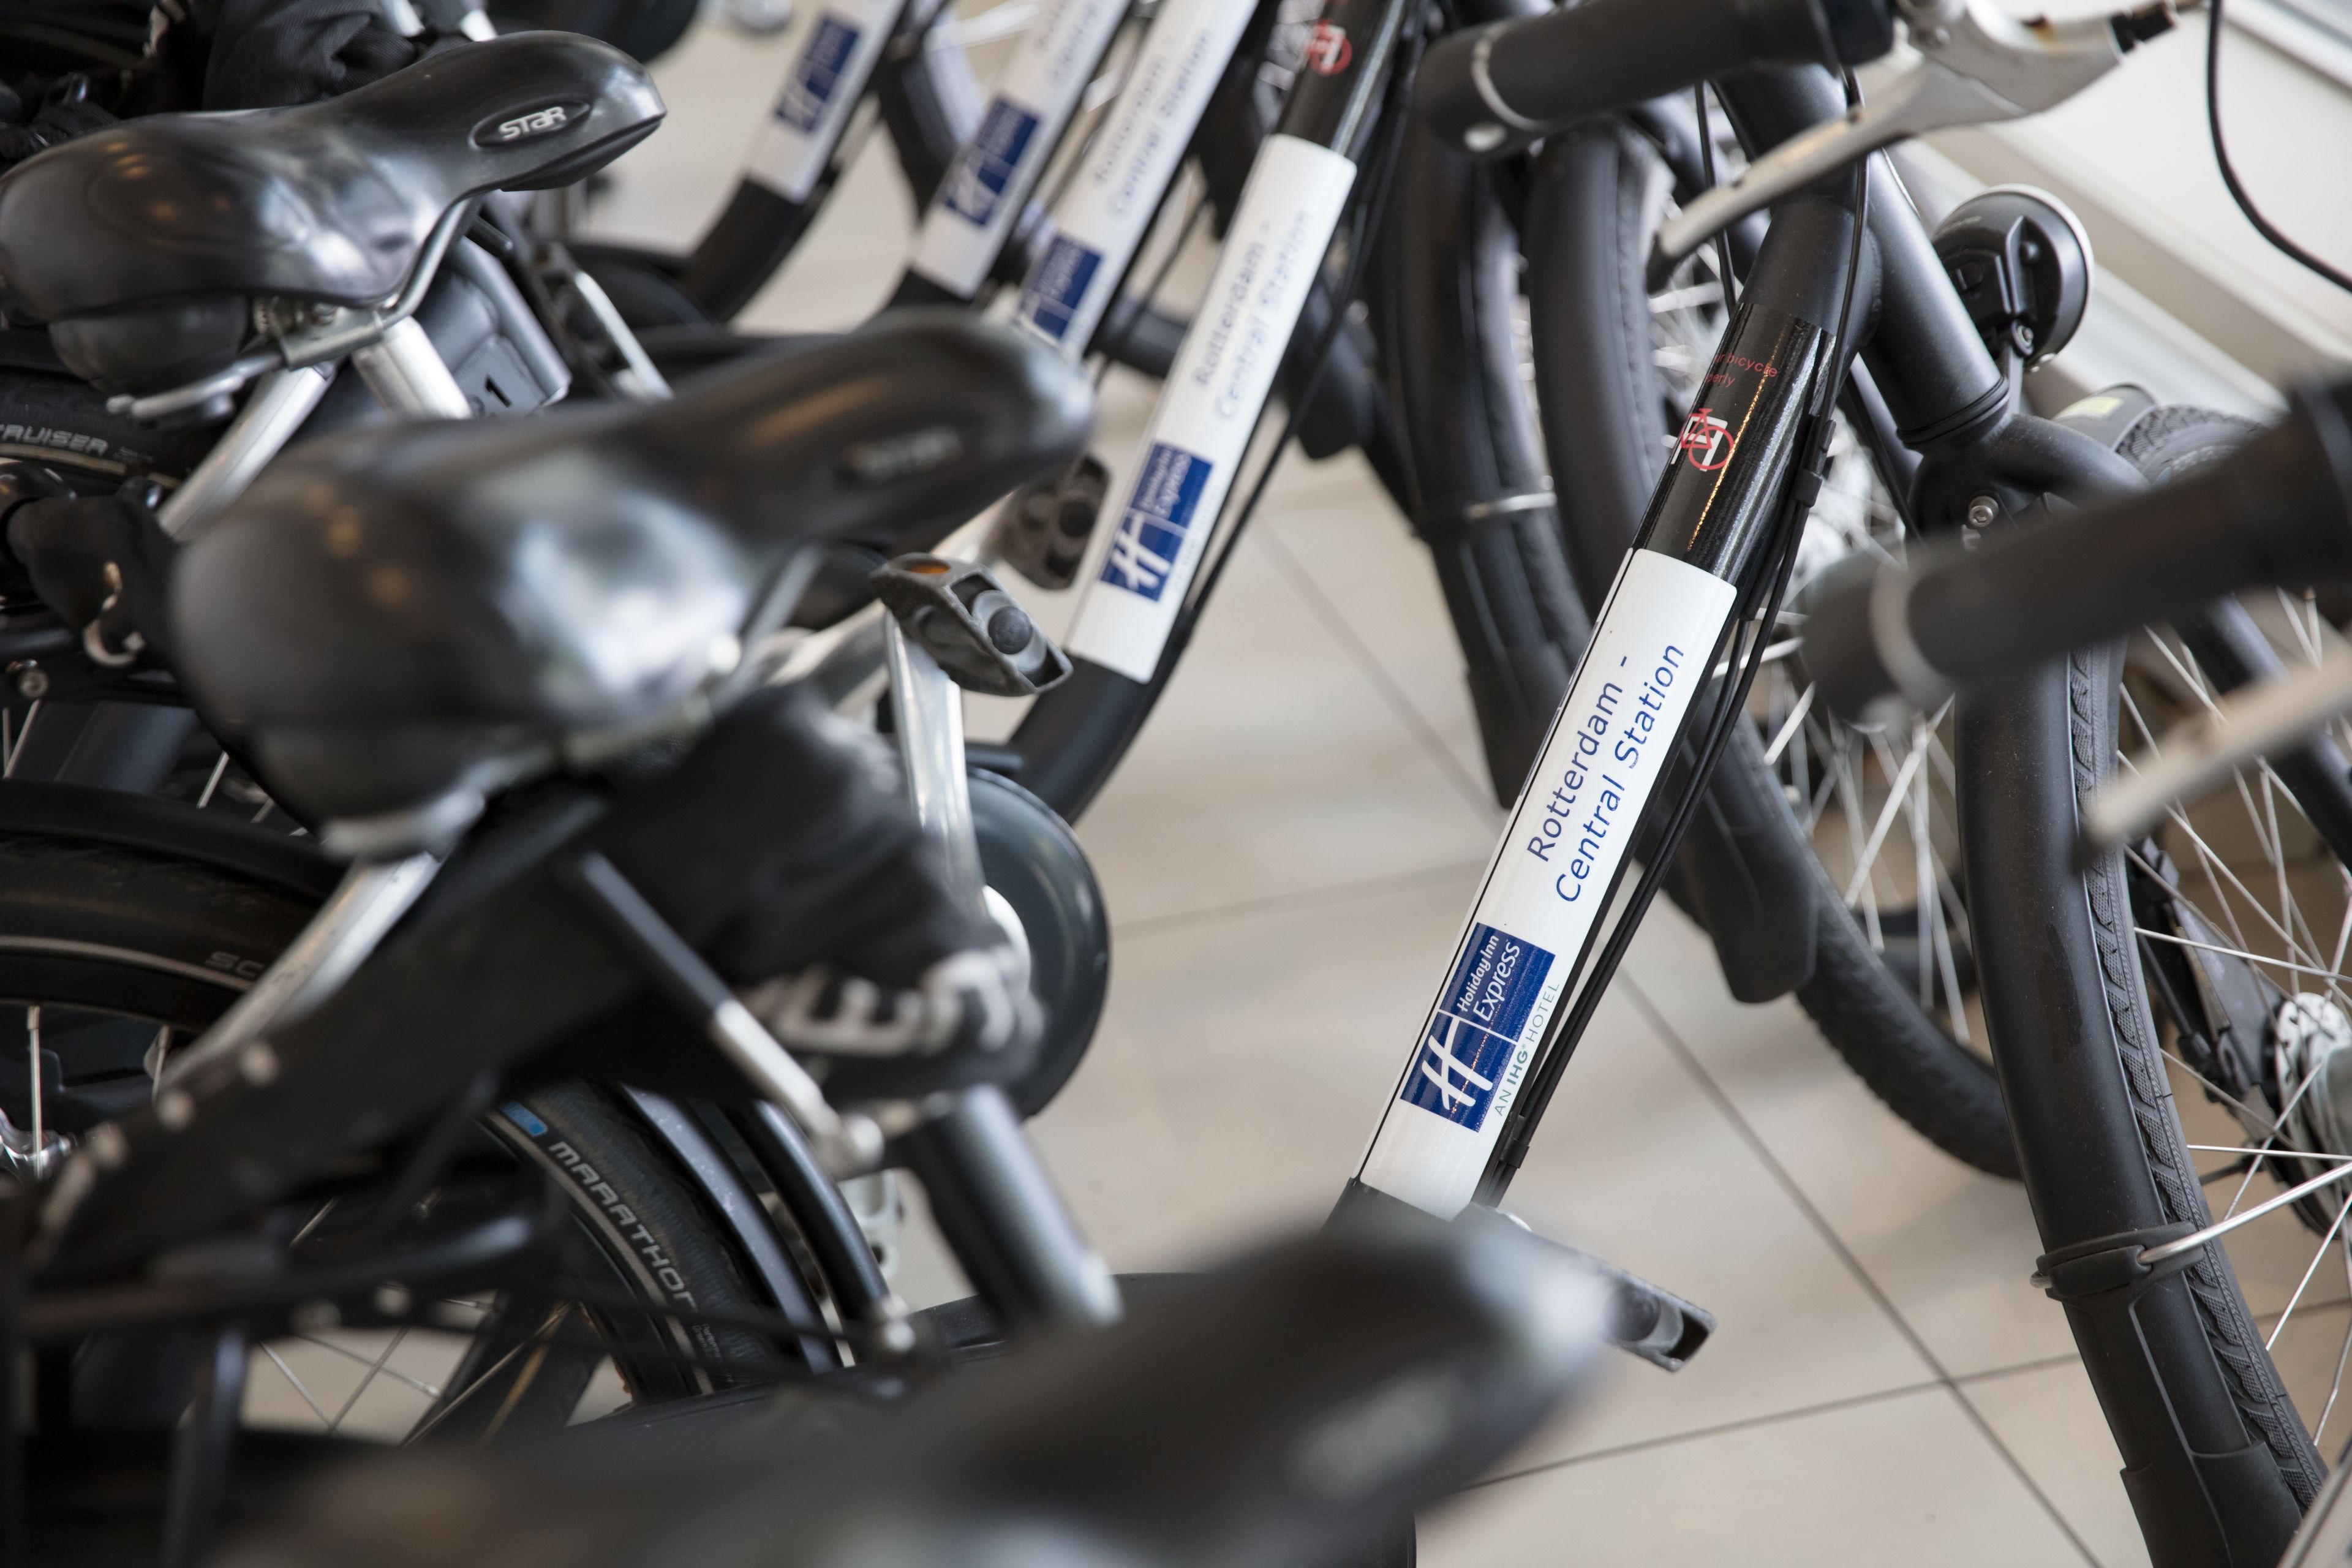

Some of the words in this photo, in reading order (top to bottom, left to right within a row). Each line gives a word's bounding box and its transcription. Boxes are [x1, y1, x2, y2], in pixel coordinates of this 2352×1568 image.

[1726, 352, 1778, 377] bicycle
[0, 424, 109, 456] RUISER
[1527, 682, 1623, 862] Rotterdam
[1556, 774, 1625, 902] Central
[1614, 645, 1684, 770] Station
[1457, 957, 1491, 1012] Holiday
[1480, 935, 1499, 959] Inn
[1472, 941, 1520, 1022] Express
[1494, 1090, 1512, 1117] AN
[1525, 982, 1560, 1042] HOTEL
